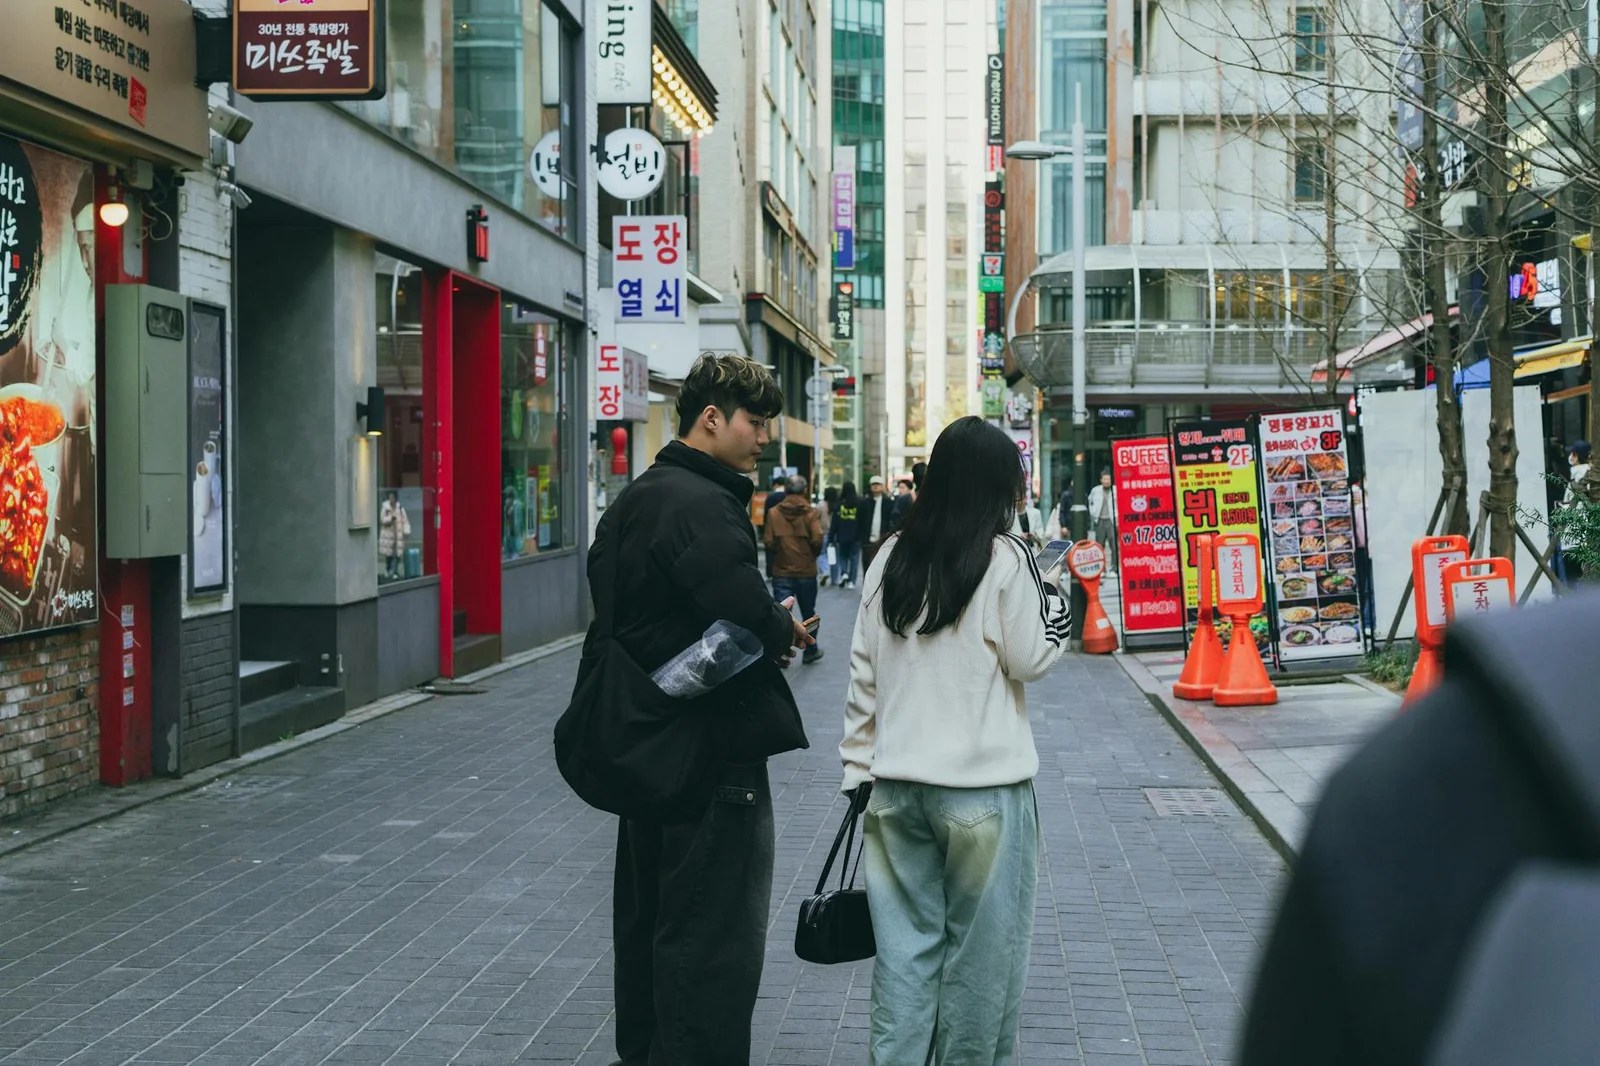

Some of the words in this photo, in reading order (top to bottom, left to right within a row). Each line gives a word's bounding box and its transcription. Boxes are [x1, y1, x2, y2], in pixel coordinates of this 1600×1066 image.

[258, 23, 282, 35] 30년
[285, 23, 305, 35] 전통
[308, 23, 349, 35] 족발명가
[55, 46, 73, 76] 윤기
[94, 65, 111, 92] 우리
[245, 39, 361, 75] 미쓰족발
[616, 222, 681, 265] 도장
[617, 278, 680, 318] 열쇠
[598, 345, 621, 417] 도장
[1268, 414, 1335, 433] 명동양꼬치
[1320, 431, 1342, 450] 3F
[1119, 446, 1169, 466] BUFFE
[1229, 446, 1251, 467] 2F
[1231, 548, 1245, 595] 주차금지
[1473, 581, 1491, 613] 주차
